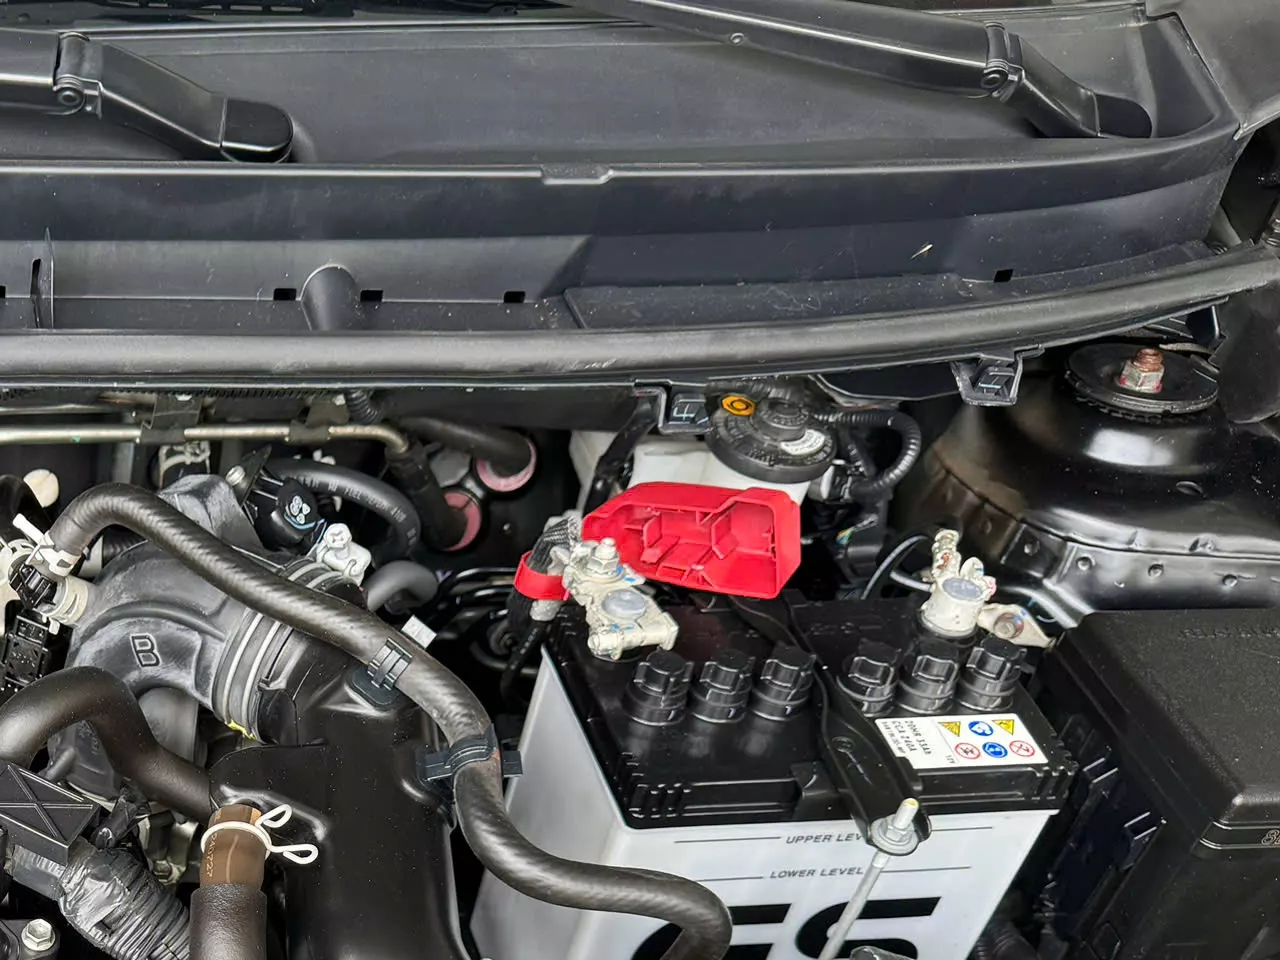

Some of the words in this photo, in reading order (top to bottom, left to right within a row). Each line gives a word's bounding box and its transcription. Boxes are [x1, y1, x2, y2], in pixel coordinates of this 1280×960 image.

[129, 633, 162, 668] B
[786, 834, 833, 844] UPPER
[836, 833, 864, 843] LEV
[769, 867, 815, 879] LOWER
[819, 866, 864, 877] LEVEL
